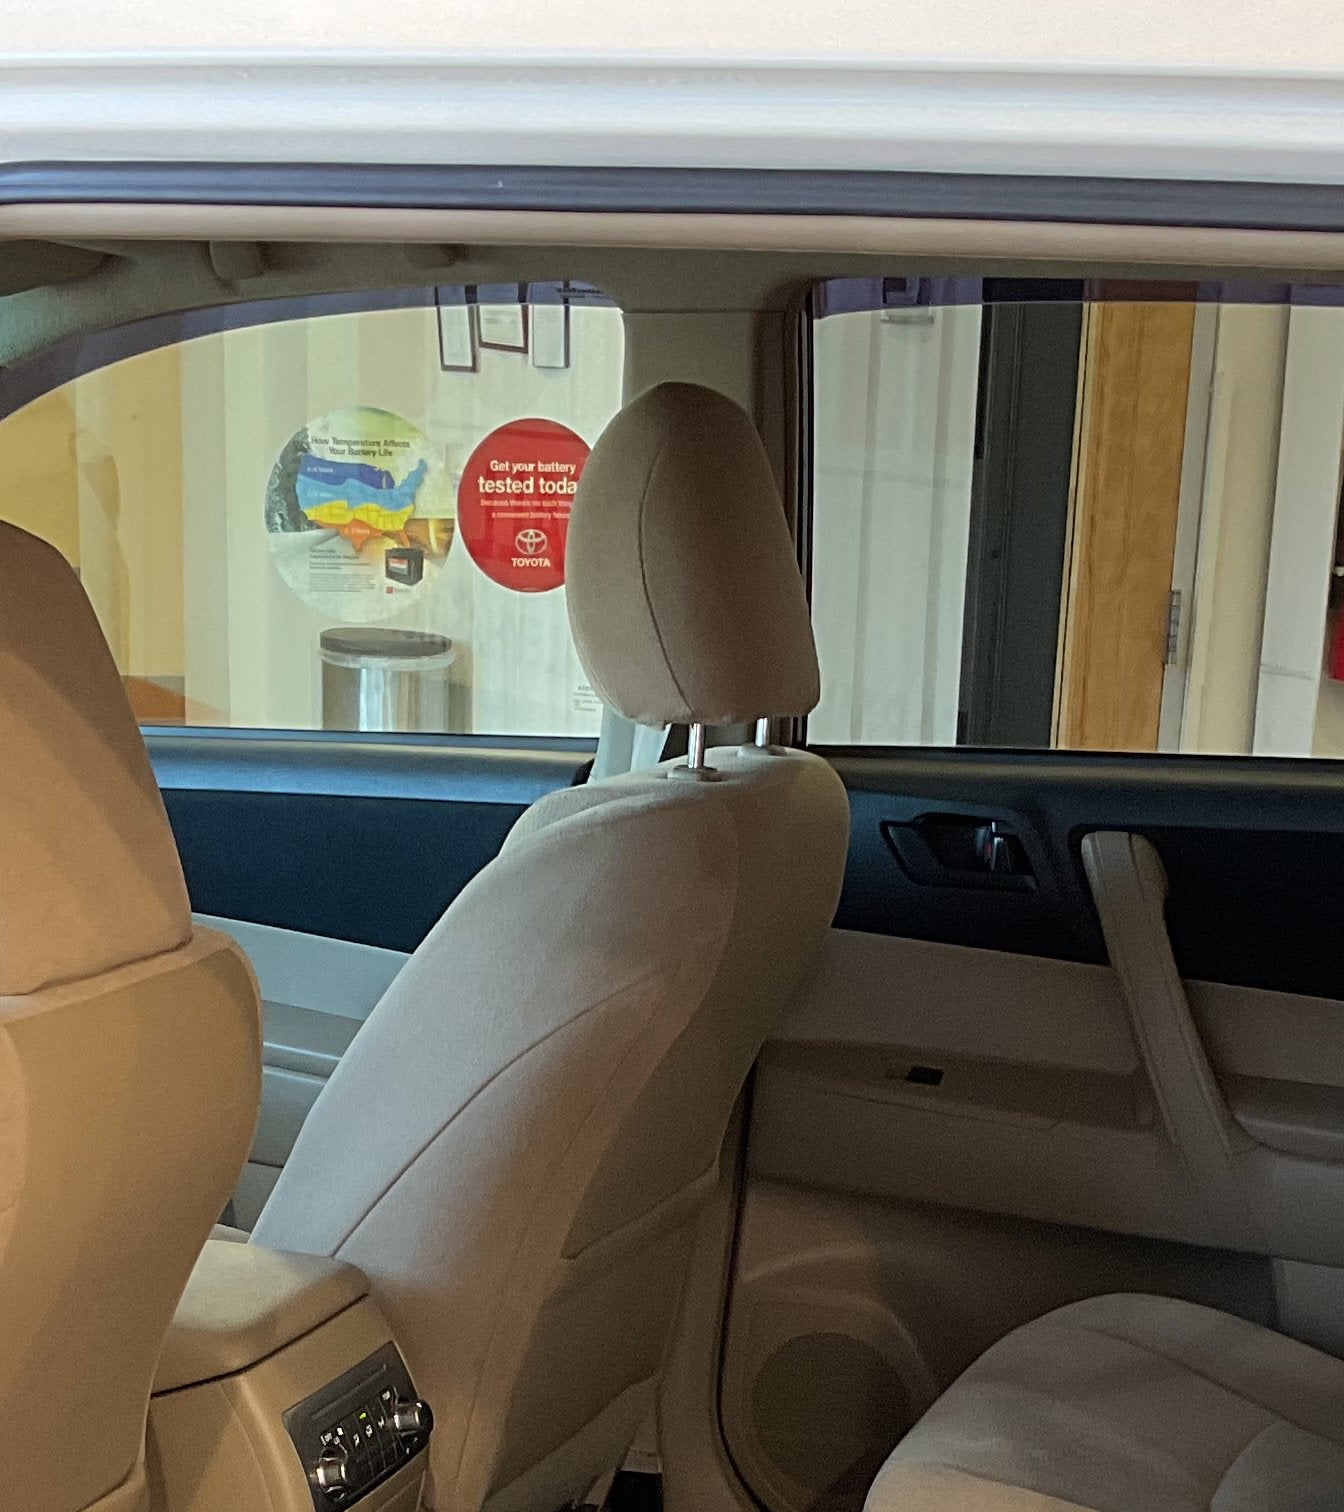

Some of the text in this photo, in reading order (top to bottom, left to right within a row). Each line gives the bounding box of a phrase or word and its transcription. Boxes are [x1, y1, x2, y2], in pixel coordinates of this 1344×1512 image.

[490, 459, 576, 475] Get your battery
[478, 475, 578, 495] tested toda
[512, 557, 551, 568] TOYOTA
